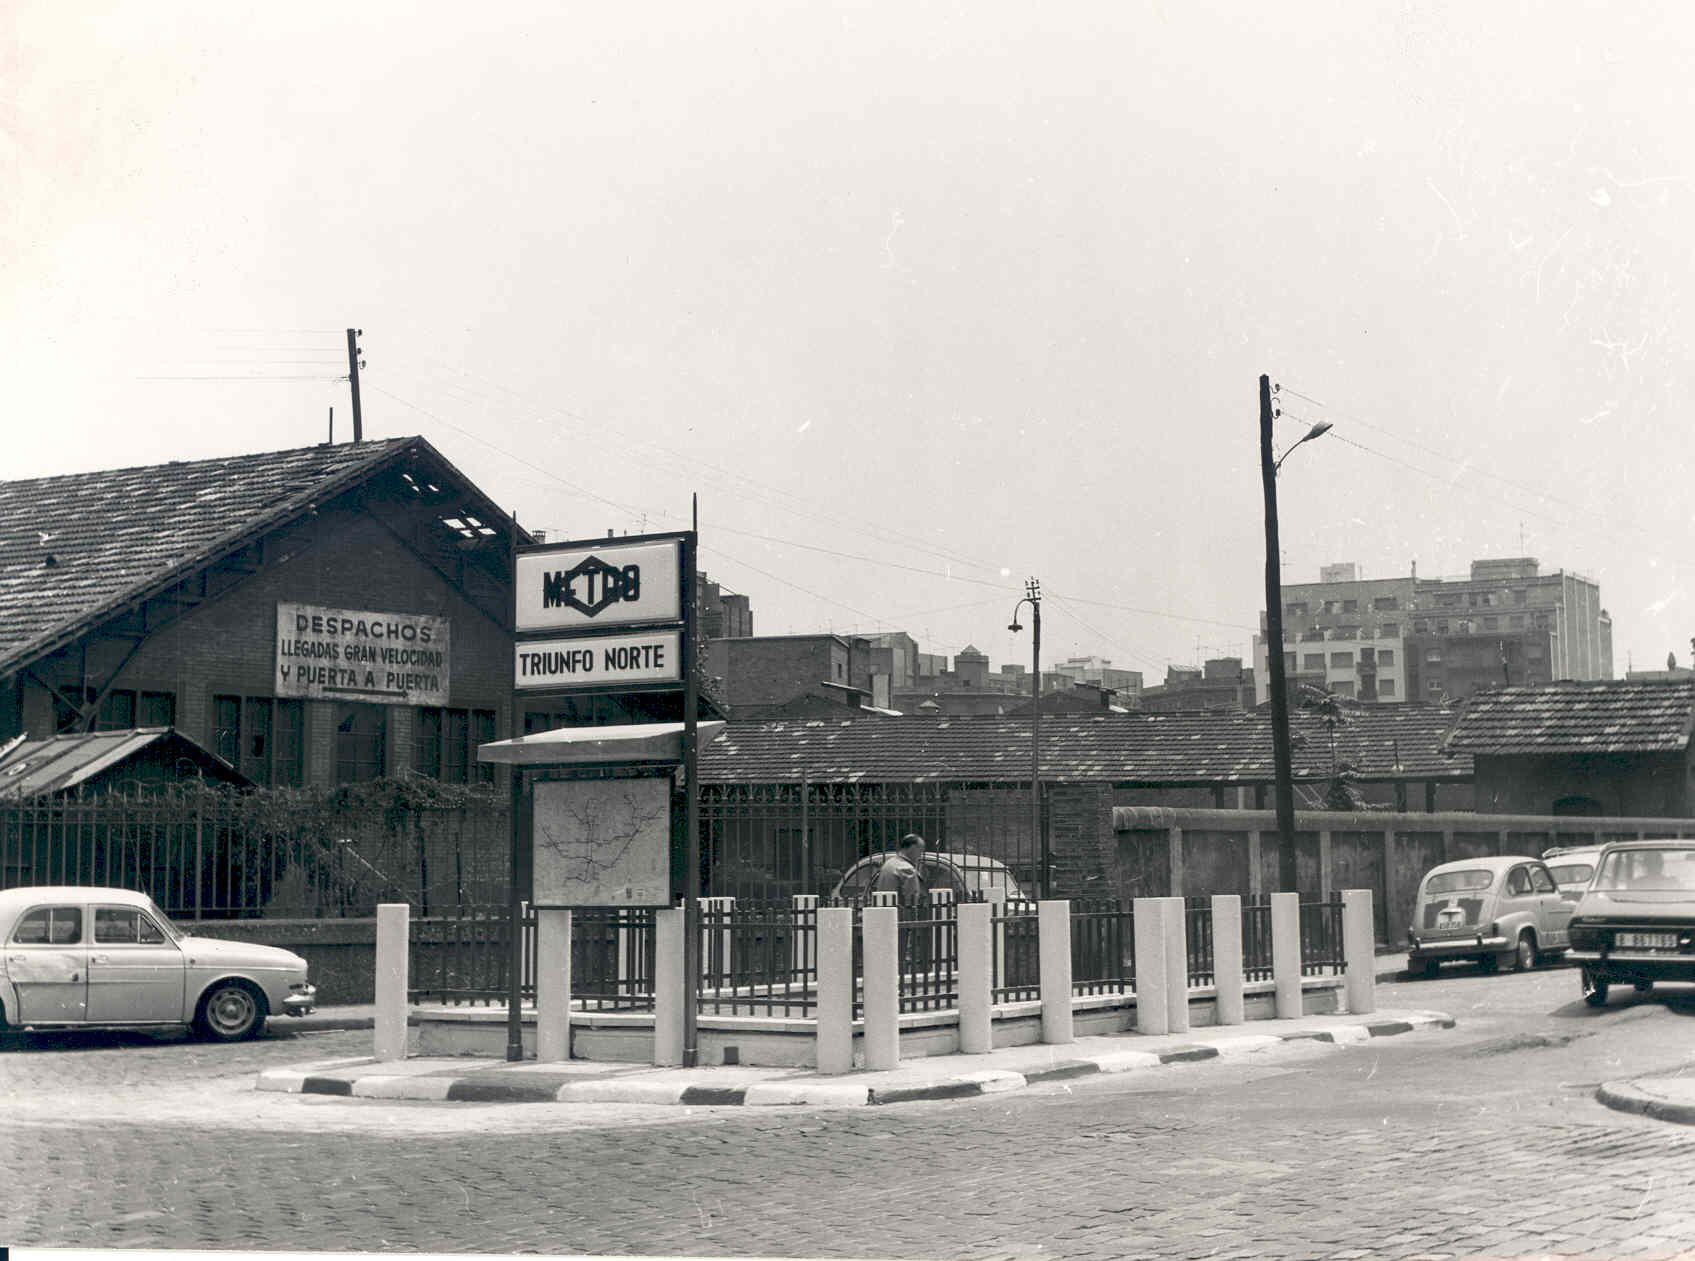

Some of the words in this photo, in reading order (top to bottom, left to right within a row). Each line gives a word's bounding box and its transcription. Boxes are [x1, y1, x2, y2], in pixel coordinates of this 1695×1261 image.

[543, 563, 640, 609] METRO
[296, 613, 432, 643] DESPACHOS
[281, 639, 340, 660] LLEGADAS
[344, 645, 376, 663] GRAN
[381, 647, 442, 668] VELOCIDAD
[520, 650, 594, 677] TRIUNFO
[605, 644, 665, 671] NORTE
[281, 664, 291, 682] Y
[296, 665, 358, 687] PUERTA
[364, 671, 376, 688] A
[386, 671, 439, 692] PUERTA
